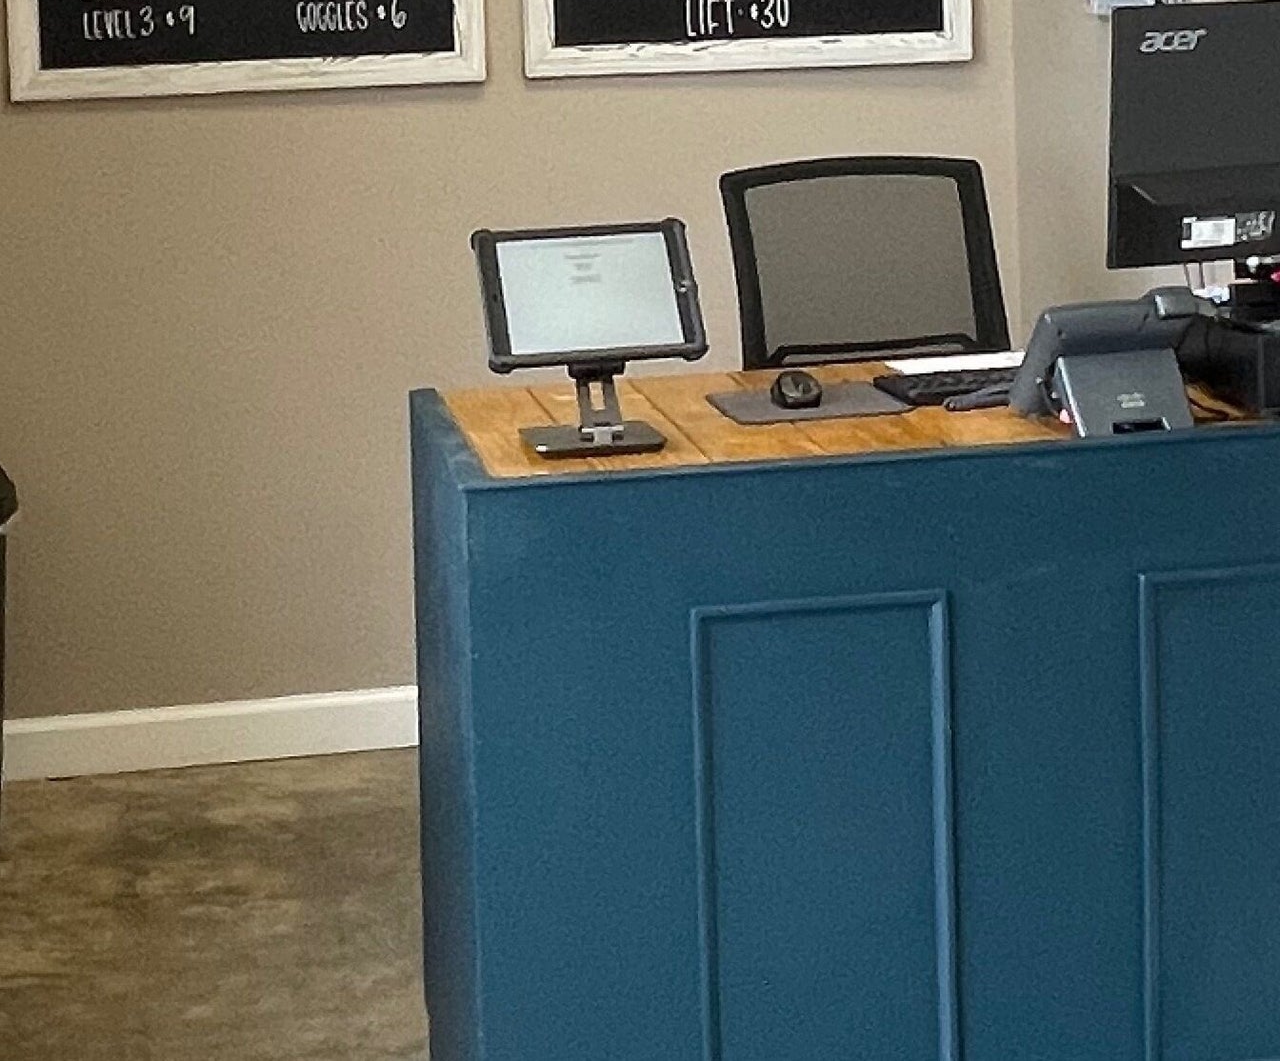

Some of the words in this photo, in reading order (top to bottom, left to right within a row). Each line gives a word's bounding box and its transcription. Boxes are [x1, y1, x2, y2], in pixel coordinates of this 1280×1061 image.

[83, 9, 133, 39] LEVEL
[139, 5, 154, 37] 3
[166, 5, 195, 35] $9
[296, 0, 369, 33] GOGGLES
[1140, 29, 1208, 52] acer
